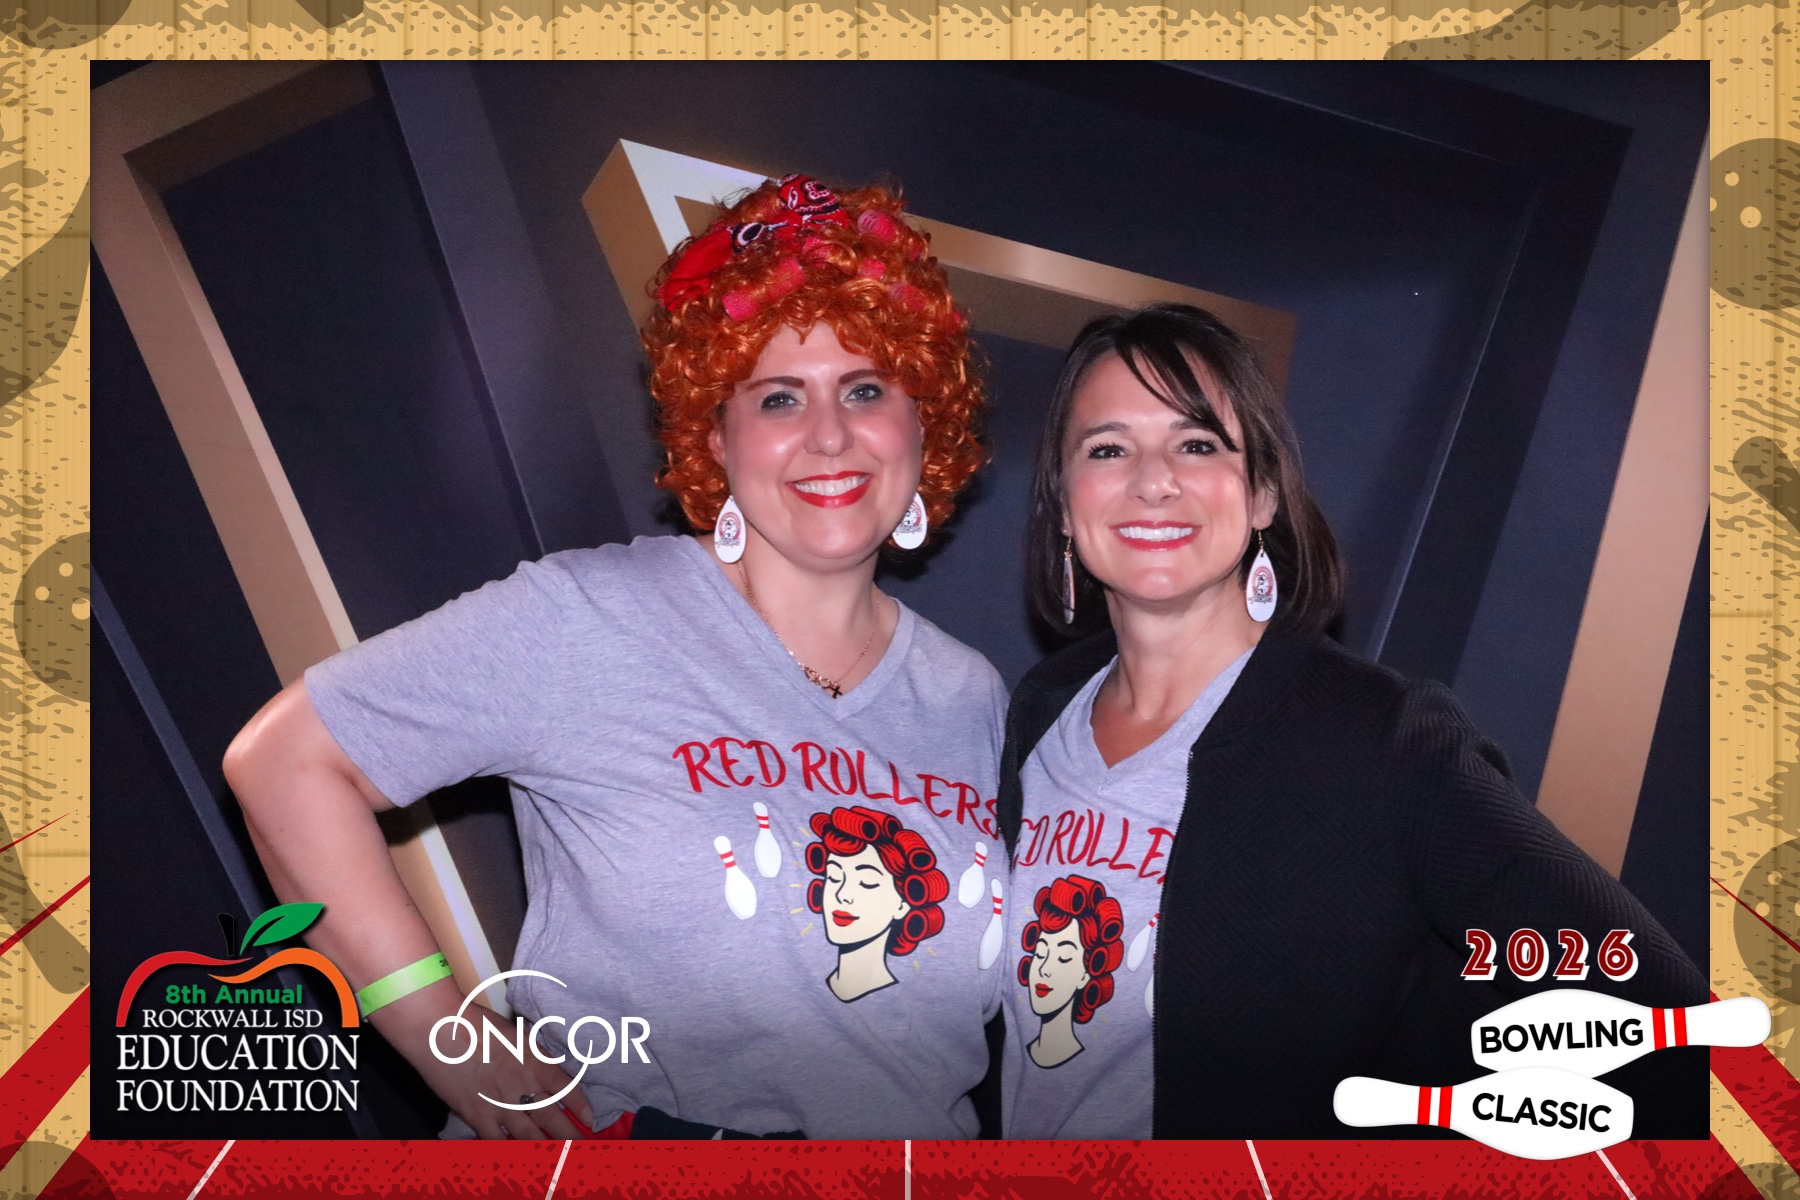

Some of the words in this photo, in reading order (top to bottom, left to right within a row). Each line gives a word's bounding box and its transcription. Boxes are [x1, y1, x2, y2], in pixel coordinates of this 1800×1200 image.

[671, 736, 787, 792] RED
[791, 742, 999, 841] ROLLERS
[1046, 808, 1175, 885] ROLLE
